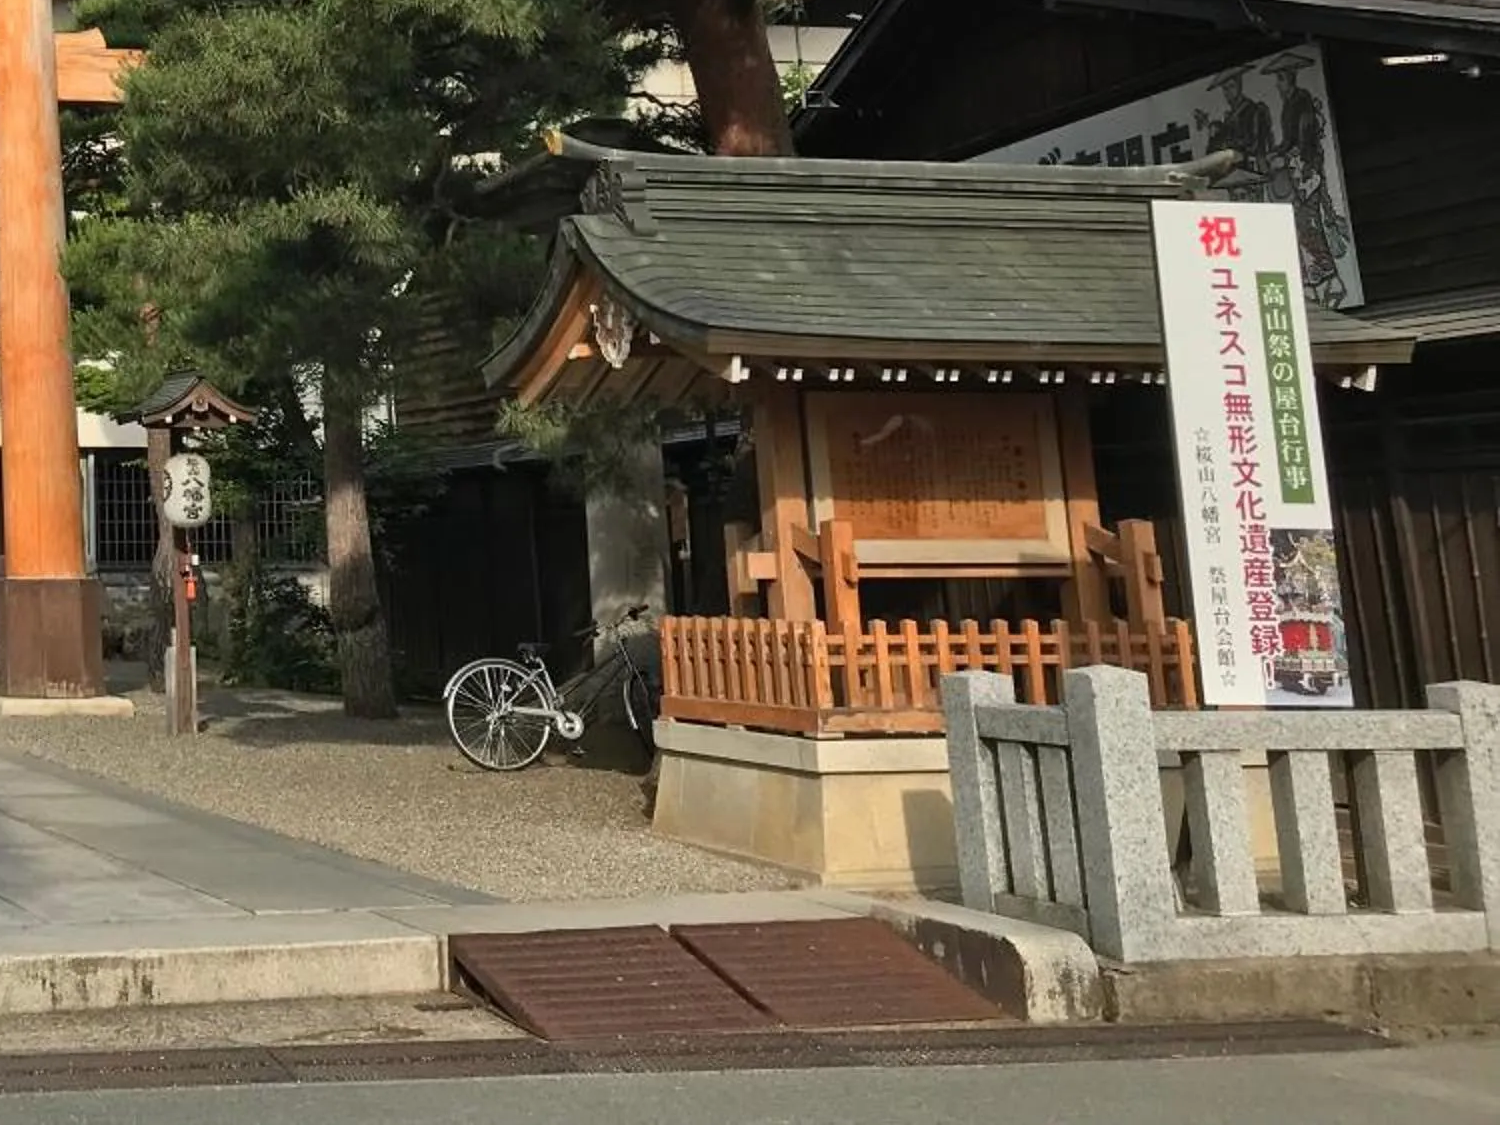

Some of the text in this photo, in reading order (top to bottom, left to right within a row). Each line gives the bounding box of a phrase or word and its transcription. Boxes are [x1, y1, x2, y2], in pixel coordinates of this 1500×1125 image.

[1199, 216, 1242, 259] 祝
[1260, 281, 1307, 491] 高山祭の屋台行事
